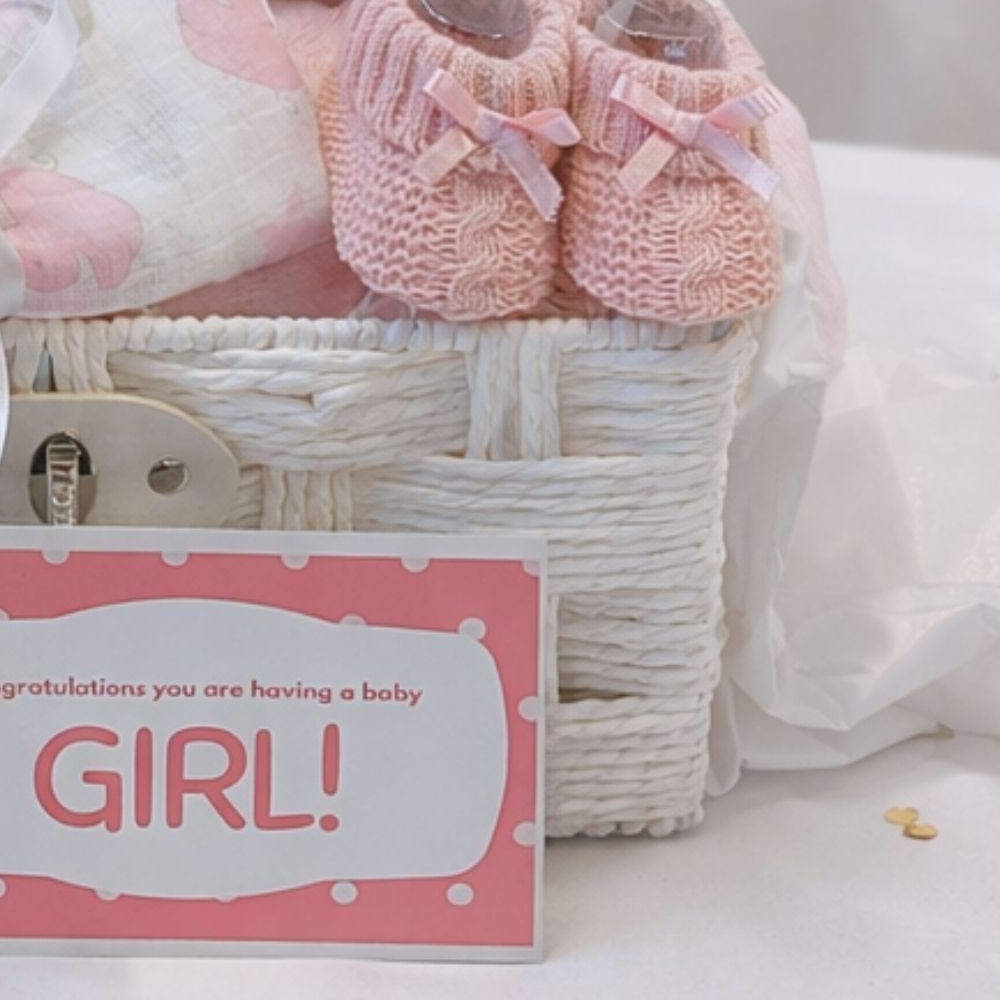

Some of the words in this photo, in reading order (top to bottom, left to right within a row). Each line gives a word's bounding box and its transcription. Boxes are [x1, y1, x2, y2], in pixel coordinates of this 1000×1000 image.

[152, 683, 197, 702] you
[203, 684, 244, 699] are
[251, 679, 333, 704] having
[340, 689, 356, 701] a
[362, 681, 424, 707] baby
[33, 722, 341, 834] GIRL!
